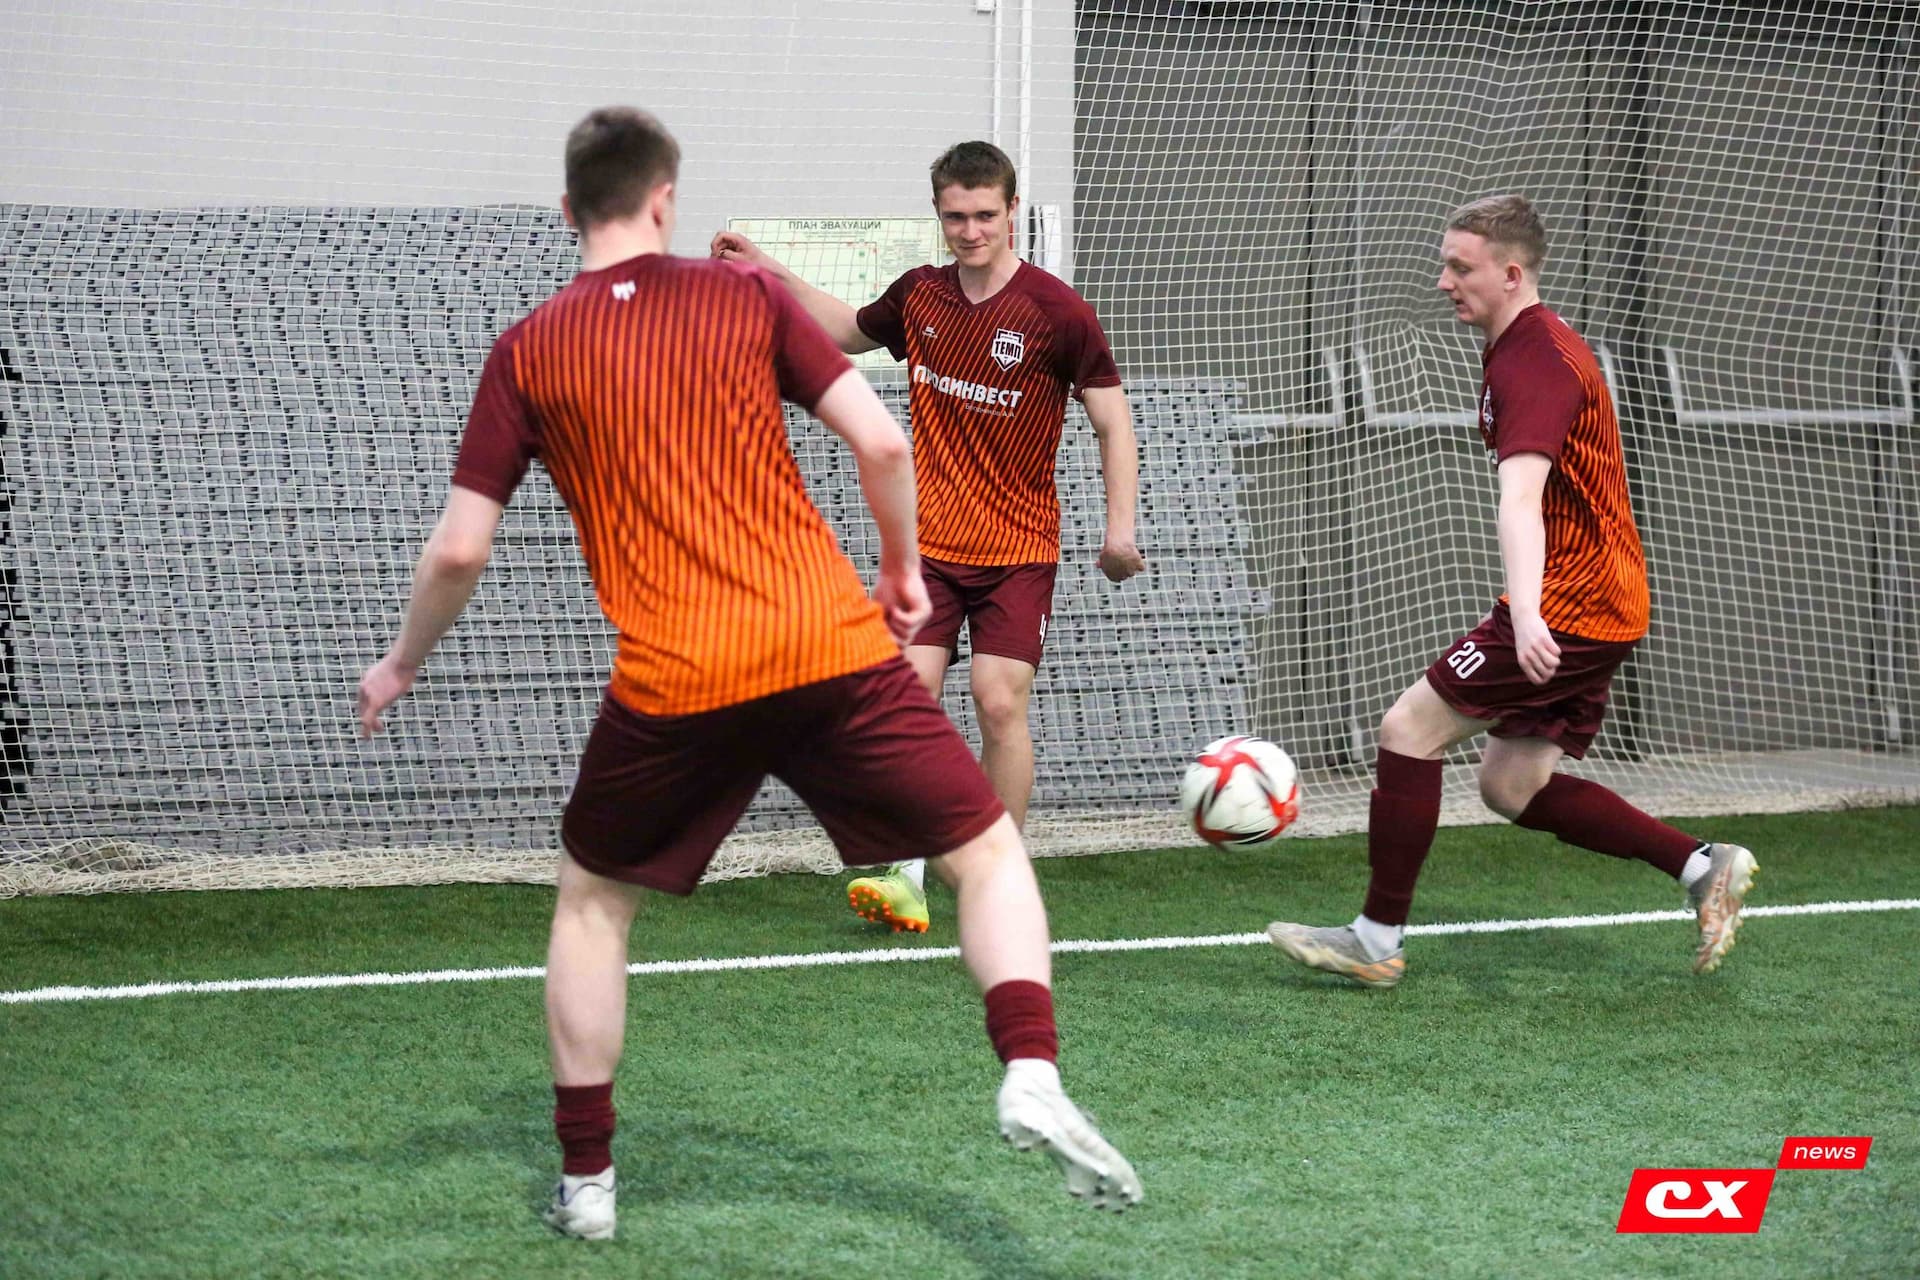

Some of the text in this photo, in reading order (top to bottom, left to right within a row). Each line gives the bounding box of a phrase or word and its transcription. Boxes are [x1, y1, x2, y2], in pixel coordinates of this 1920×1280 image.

[789, 221, 881, 230] ПЛАН ЭВАКУАЦИИ
[995, 341, 1021, 360] ТЕМП
[1447, 641, 1486, 679] 20
